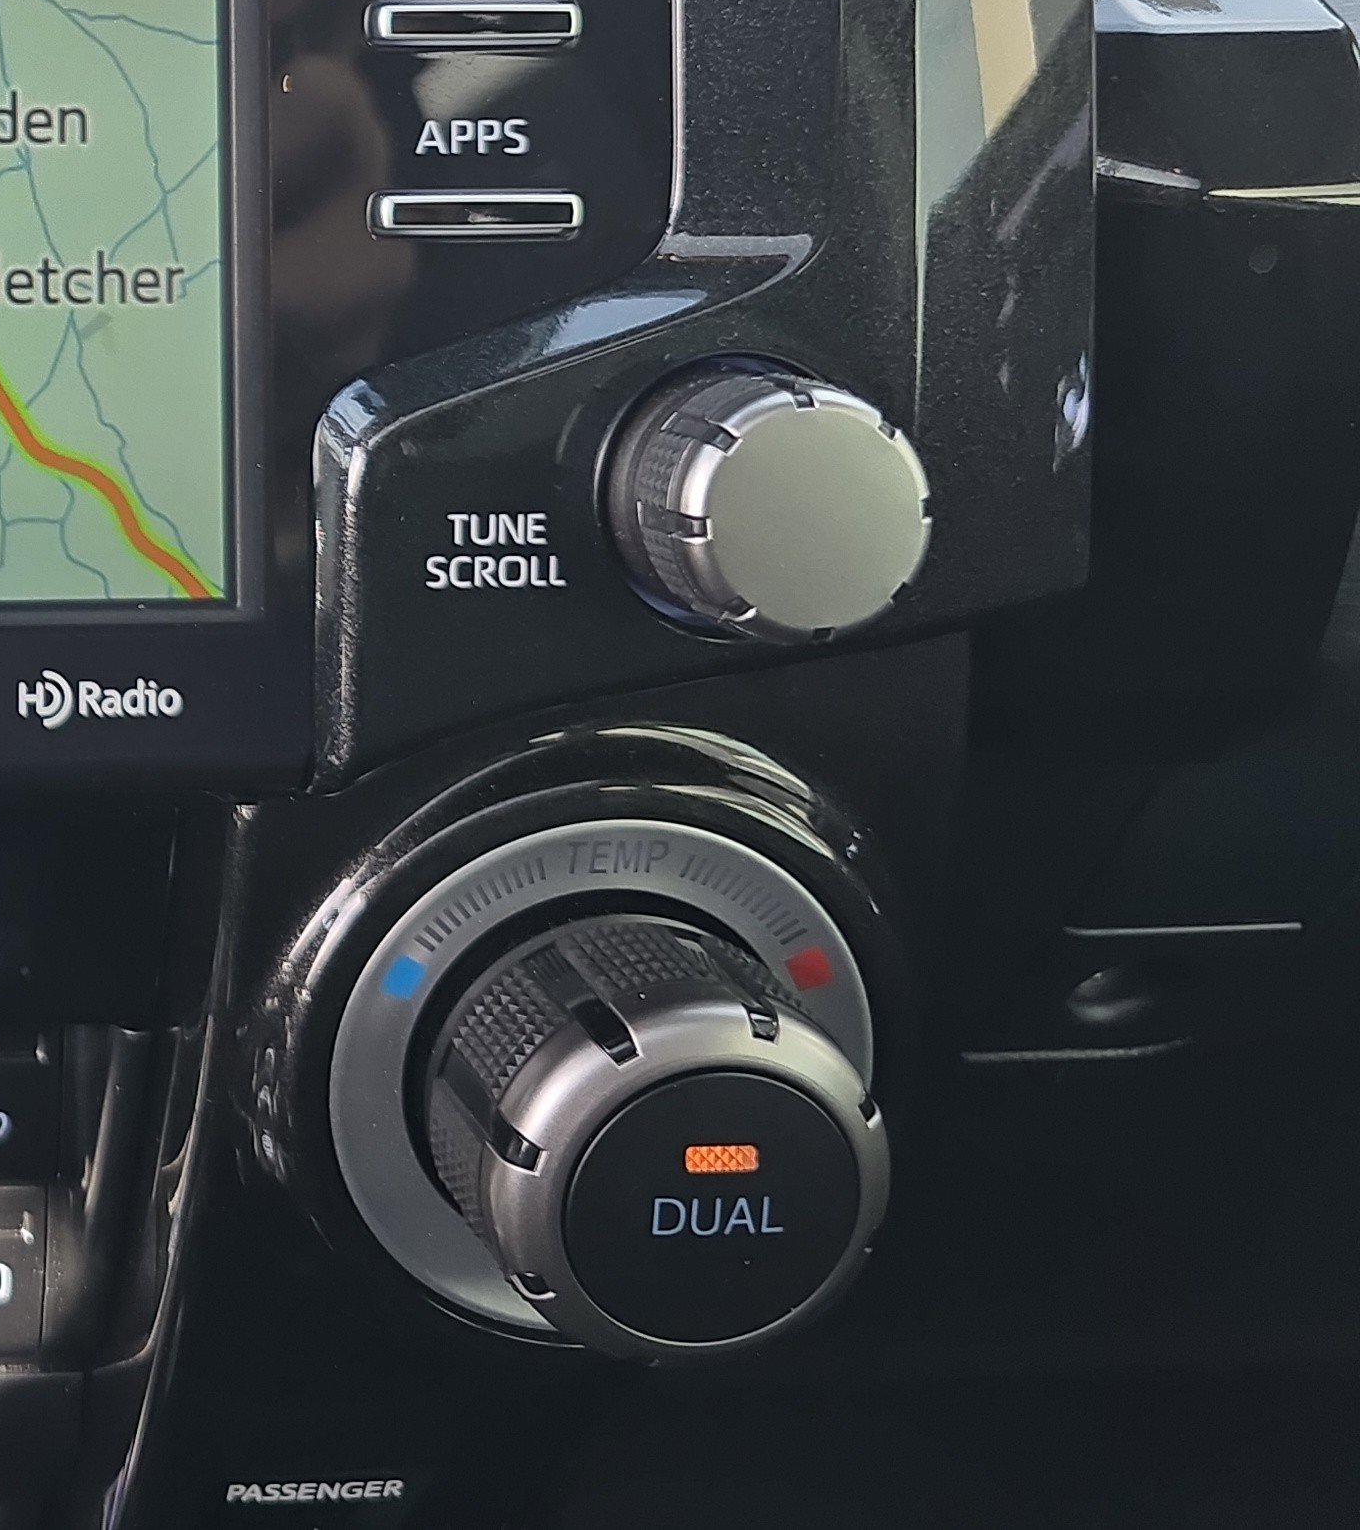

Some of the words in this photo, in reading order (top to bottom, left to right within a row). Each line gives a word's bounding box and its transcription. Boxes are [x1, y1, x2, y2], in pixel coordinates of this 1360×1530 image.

[415, 119, 530, 154] APPS
[447, 513, 548, 546] TUNE
[424, 555, 567, 589] SCROLL
[79, 676, 184, 718] Radio
[564, 839, 672, 875] TEMP
[651, 1196, 783, 1236] DUAL
[226, 1479, 404, 1503] PASSENGER
